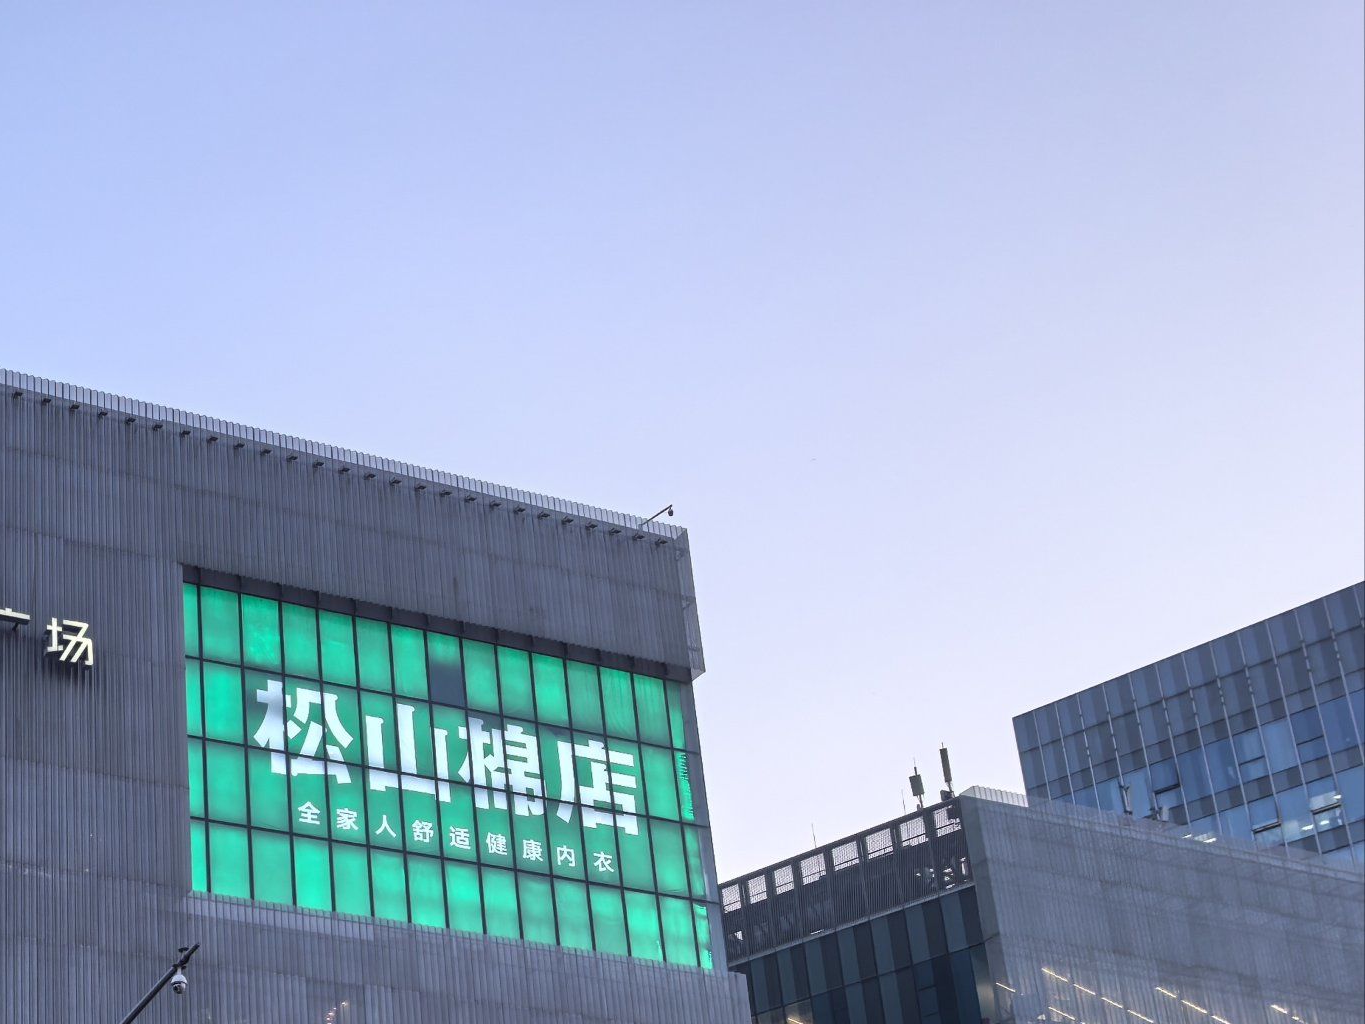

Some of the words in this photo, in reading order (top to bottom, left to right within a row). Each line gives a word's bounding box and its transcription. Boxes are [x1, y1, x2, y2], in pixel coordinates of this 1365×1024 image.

[253, 679, 640, 836] 松山棉店
[298, 801, 615, 874] 全家人舒适健康内衣
